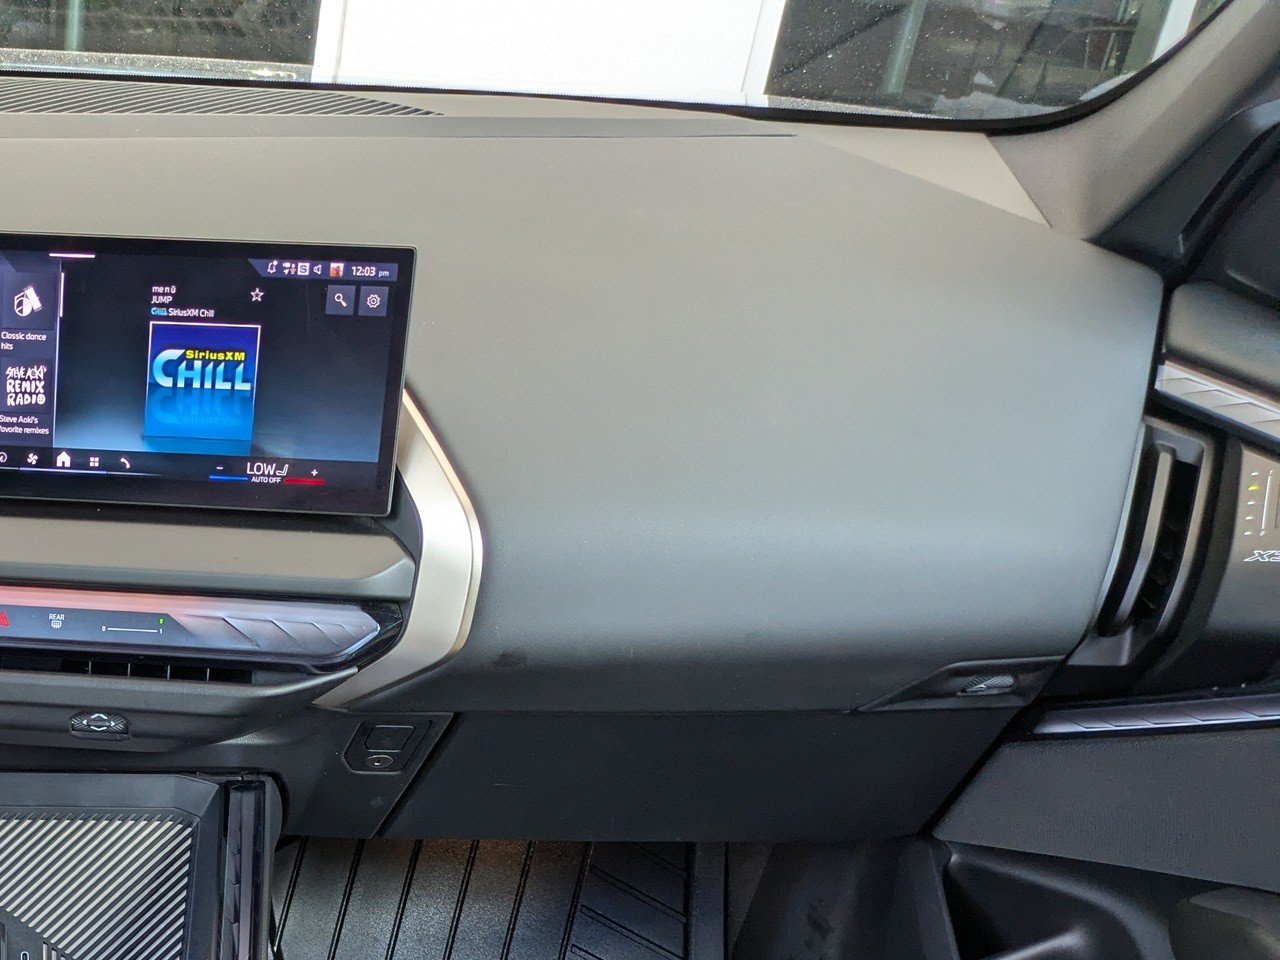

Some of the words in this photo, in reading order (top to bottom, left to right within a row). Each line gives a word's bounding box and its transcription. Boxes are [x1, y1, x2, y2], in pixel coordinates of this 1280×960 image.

[351, 266, 376, 276] 12:03
[151, 295, 172, 304] JUMP
[168, 308, 199, 317] SiriusXM
[199, 309, 215, 318] Chill
[0, 331, 25, 341] Classic
[25, 332, 47, 341] dance
[0, 342, 14, 351] hits
[184, 349, 246, 361] SiriusXM
[152, 349, 252, 391] CHILL
[6, 379, 45, 394] REMIX
[6, 393, 47, 407] RADIO
[18, 415, 39, 424] Aoki's
[23, 427, 50, 435] remixes
[246, 462, 276, 475] LOW
[251, 476, 269, 484] AUTO
[48, 613, 65, 621] REAR
